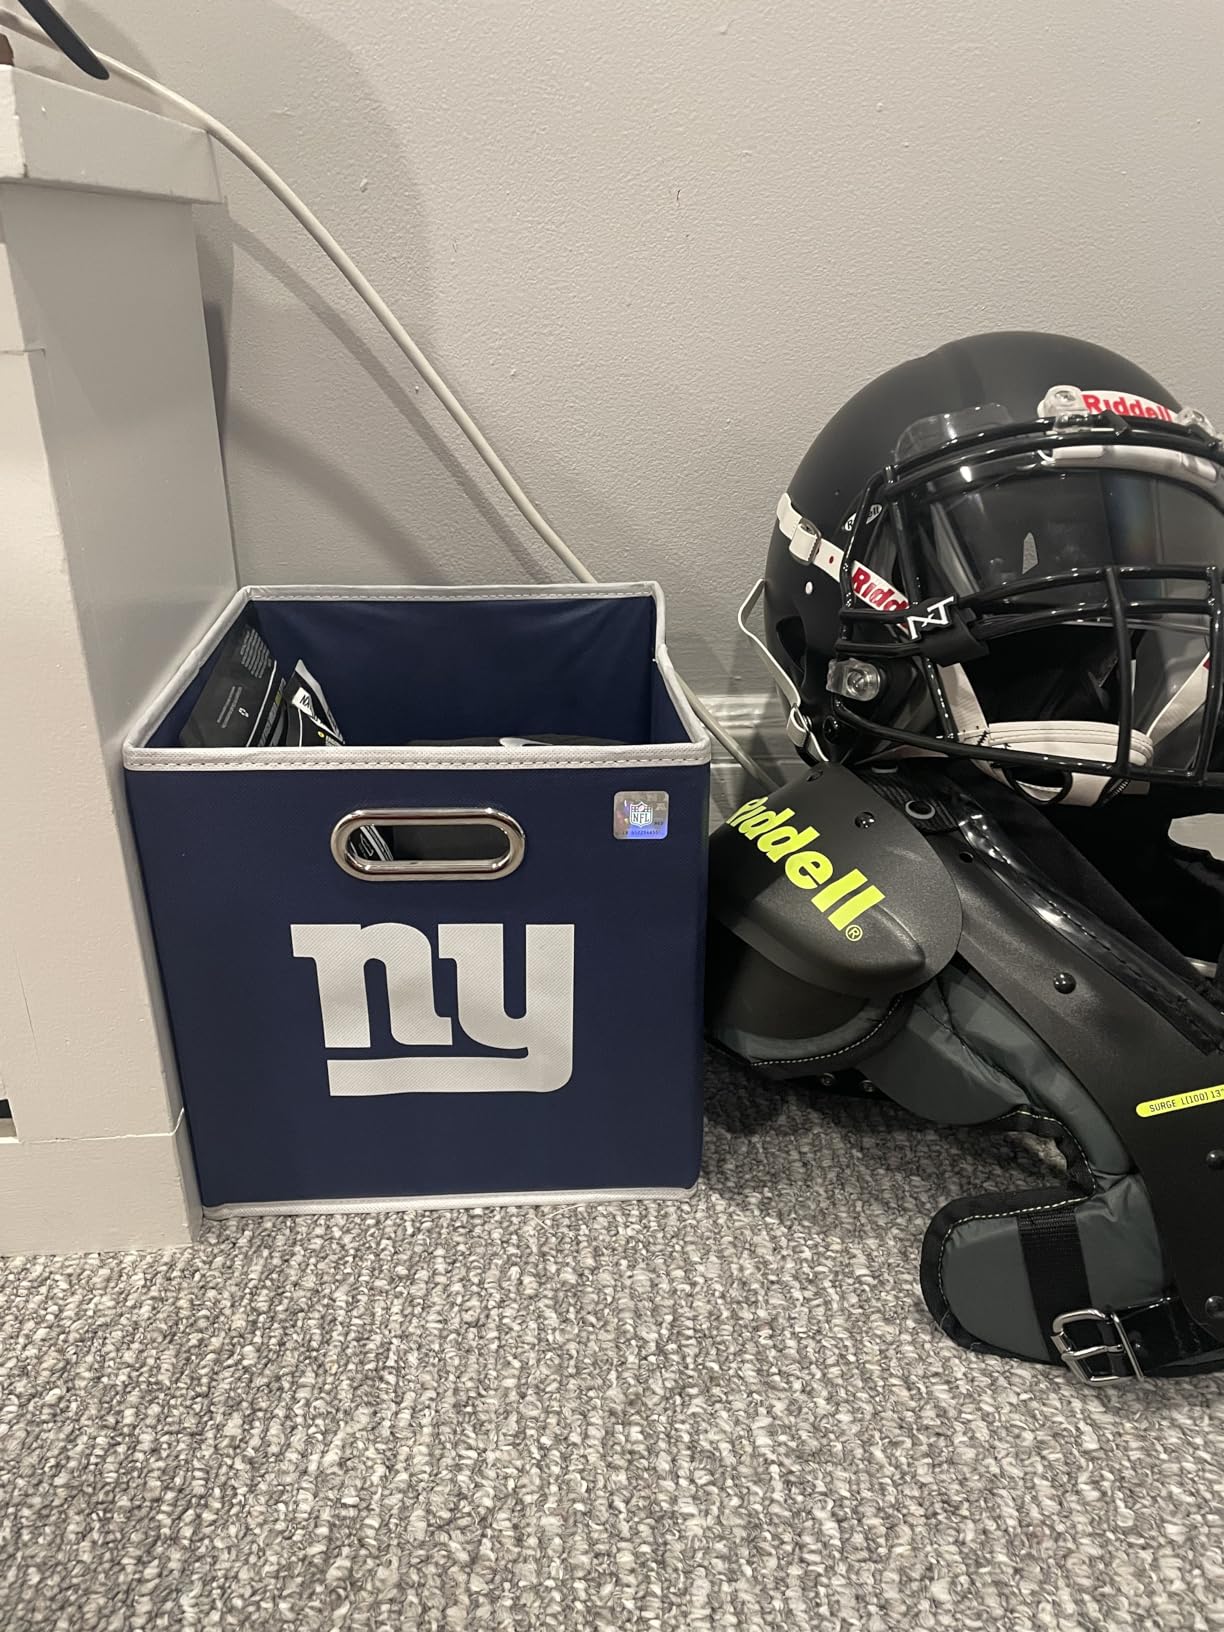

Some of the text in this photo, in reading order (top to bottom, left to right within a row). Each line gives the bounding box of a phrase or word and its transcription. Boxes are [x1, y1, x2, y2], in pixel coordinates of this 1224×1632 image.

[1081, 394, 1173, 422] Riddell
[632, 812, 650, 824] NFL
[1149, 1099, 1176, 1112] SURGE
